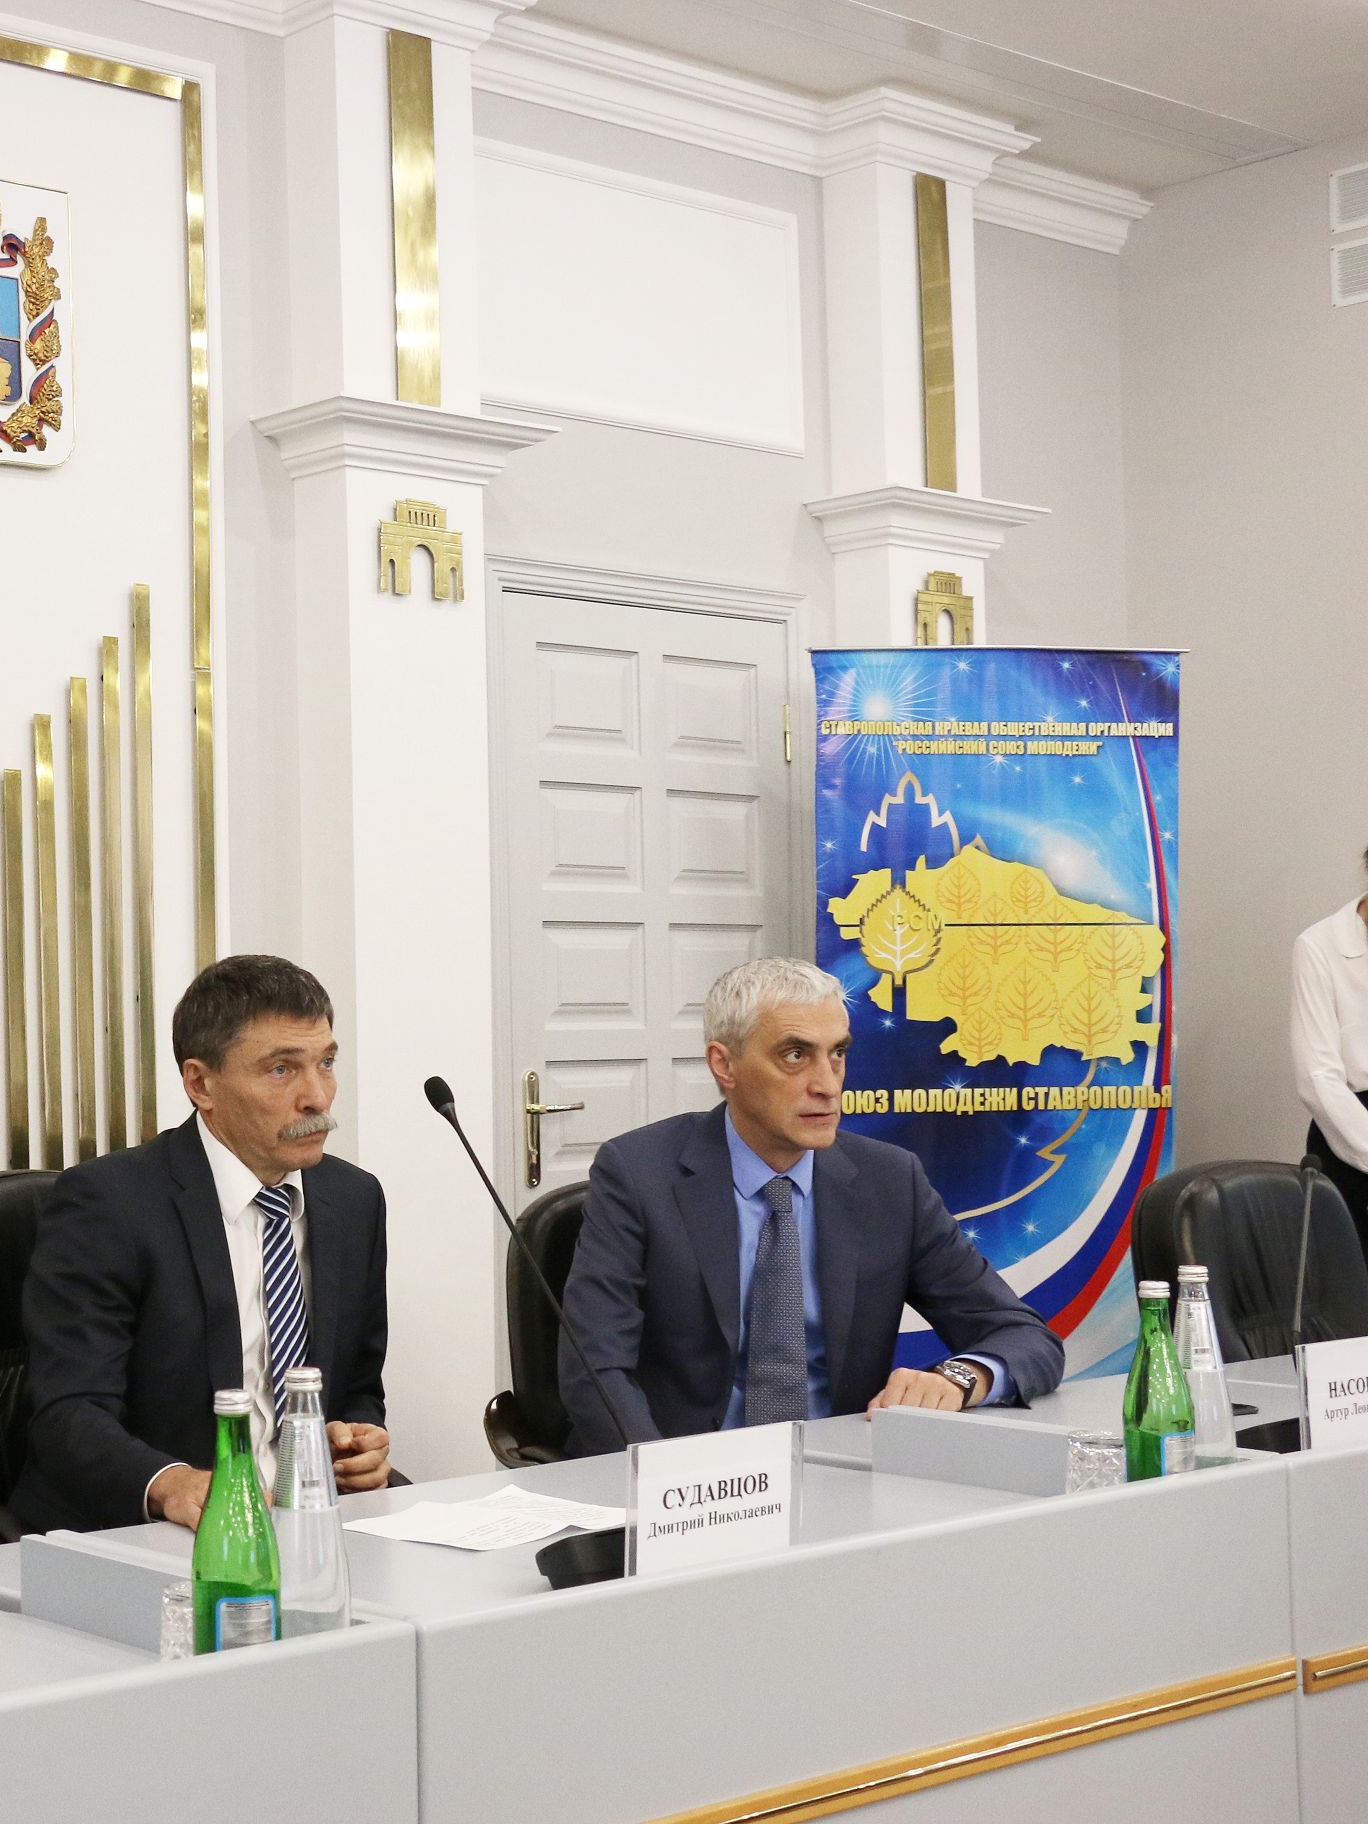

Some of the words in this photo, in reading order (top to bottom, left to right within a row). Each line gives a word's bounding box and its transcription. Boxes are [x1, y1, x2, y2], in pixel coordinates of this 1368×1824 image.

[821, 720, 932, 735] СТАВРОПОЛЬСКАЯ
[935, 721, 988, 736] КРАЕВАЯ
[991, 721, 1086, 737] ОБЩЕСТВЕННАЯ
[1088, 722, 1173, 738] ОРГАНИЗАЦИЯ
[989, 740, 1024, 755] СОЮЗ
[892, 912, 943, 932] РСМ
[841, 1089, 889, 1114] ОЮЗ
[893, 1087, 1018, 1115] МОЛОДЕЖИ
[1021, 1085, 1172, 1111] СТАВРОПОЛЬЯ
[1328, 1376, 1368, 1399] НАСО
[1324, 1407, 1350, 1422] Артур
[1351, 1402, 1368, 1416] Лео
[662, 1472, 769, 1510] СУДАВЦОВ
[647, 1513, 705, 1540] Дмитрий
[708, 1502, 782, 1527] Николаевич
